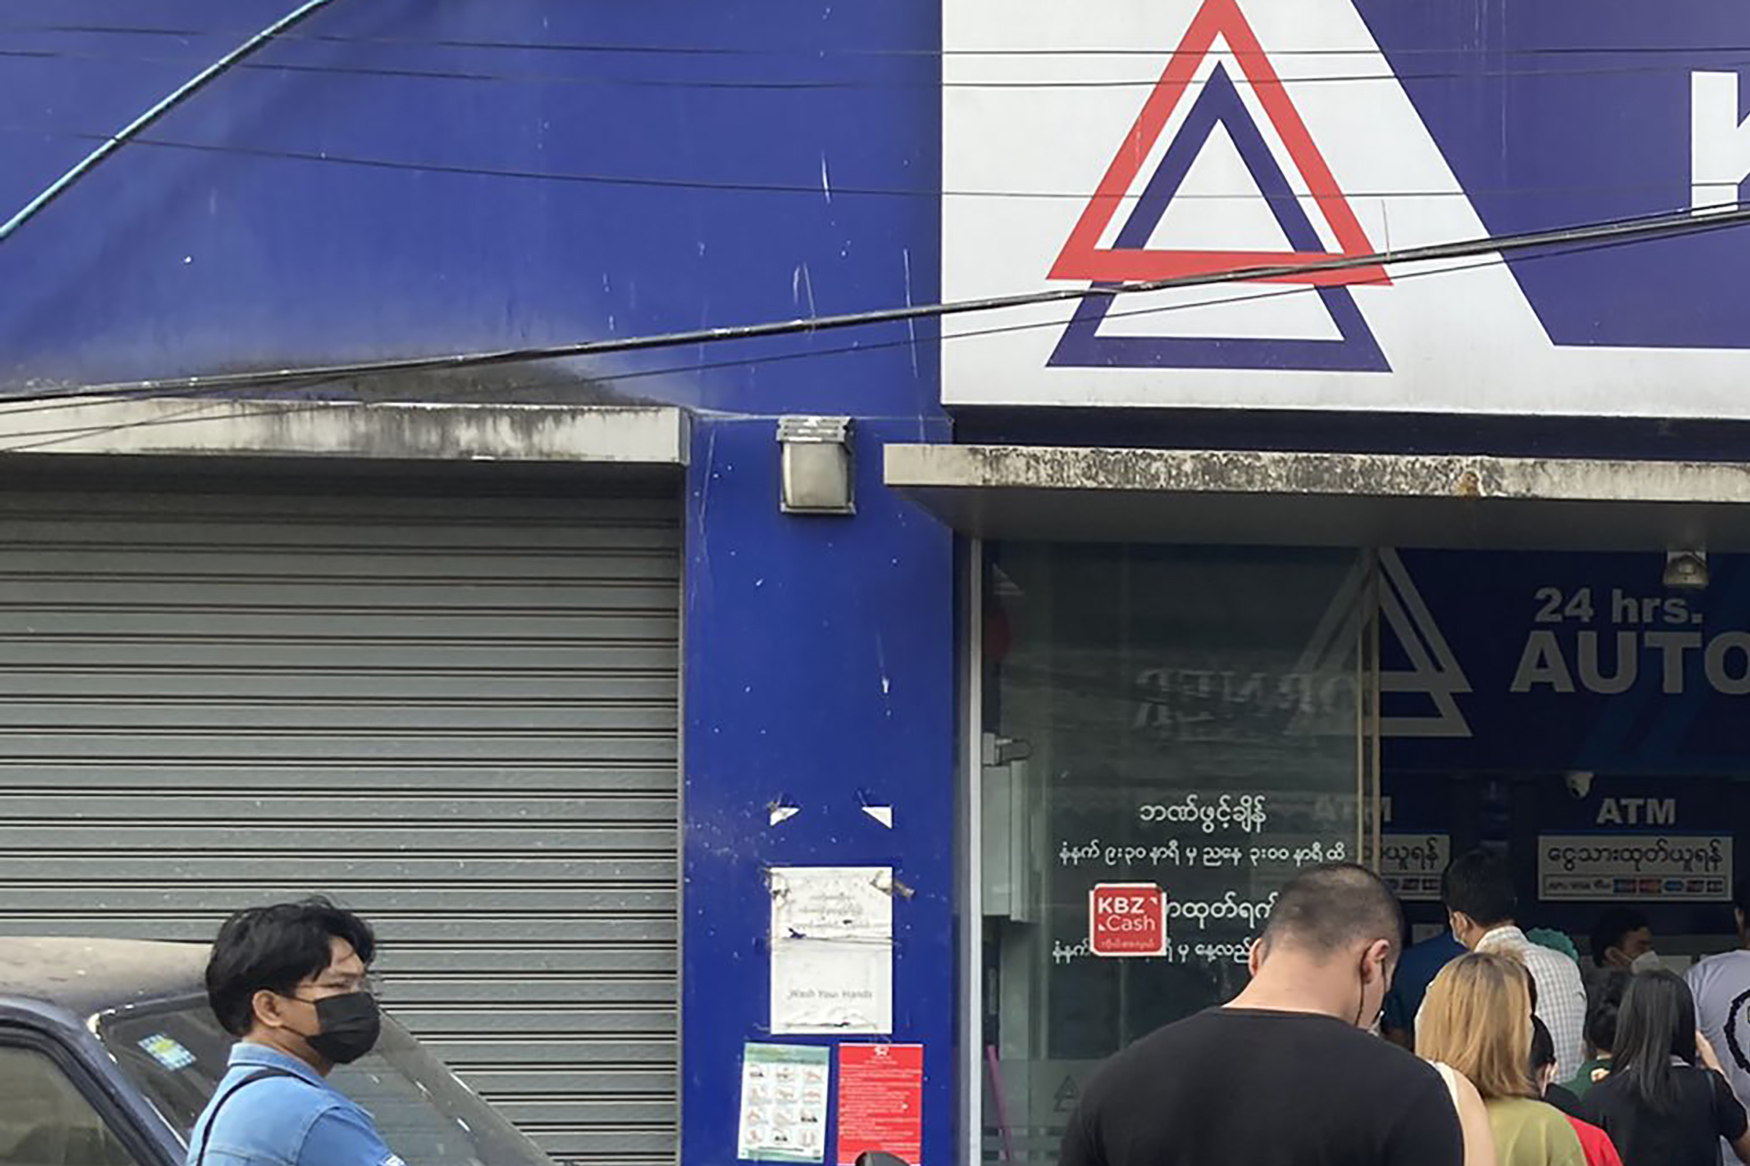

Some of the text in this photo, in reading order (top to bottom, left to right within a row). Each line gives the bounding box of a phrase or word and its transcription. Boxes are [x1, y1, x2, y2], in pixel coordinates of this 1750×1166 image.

[1534, 587, 1703, 624] 24 hrs.
[1596, 797, 1677, 825] ATM
[1098, 896, 1145, 914] KBZ
[1106, 914, 1156, 932] Cash
